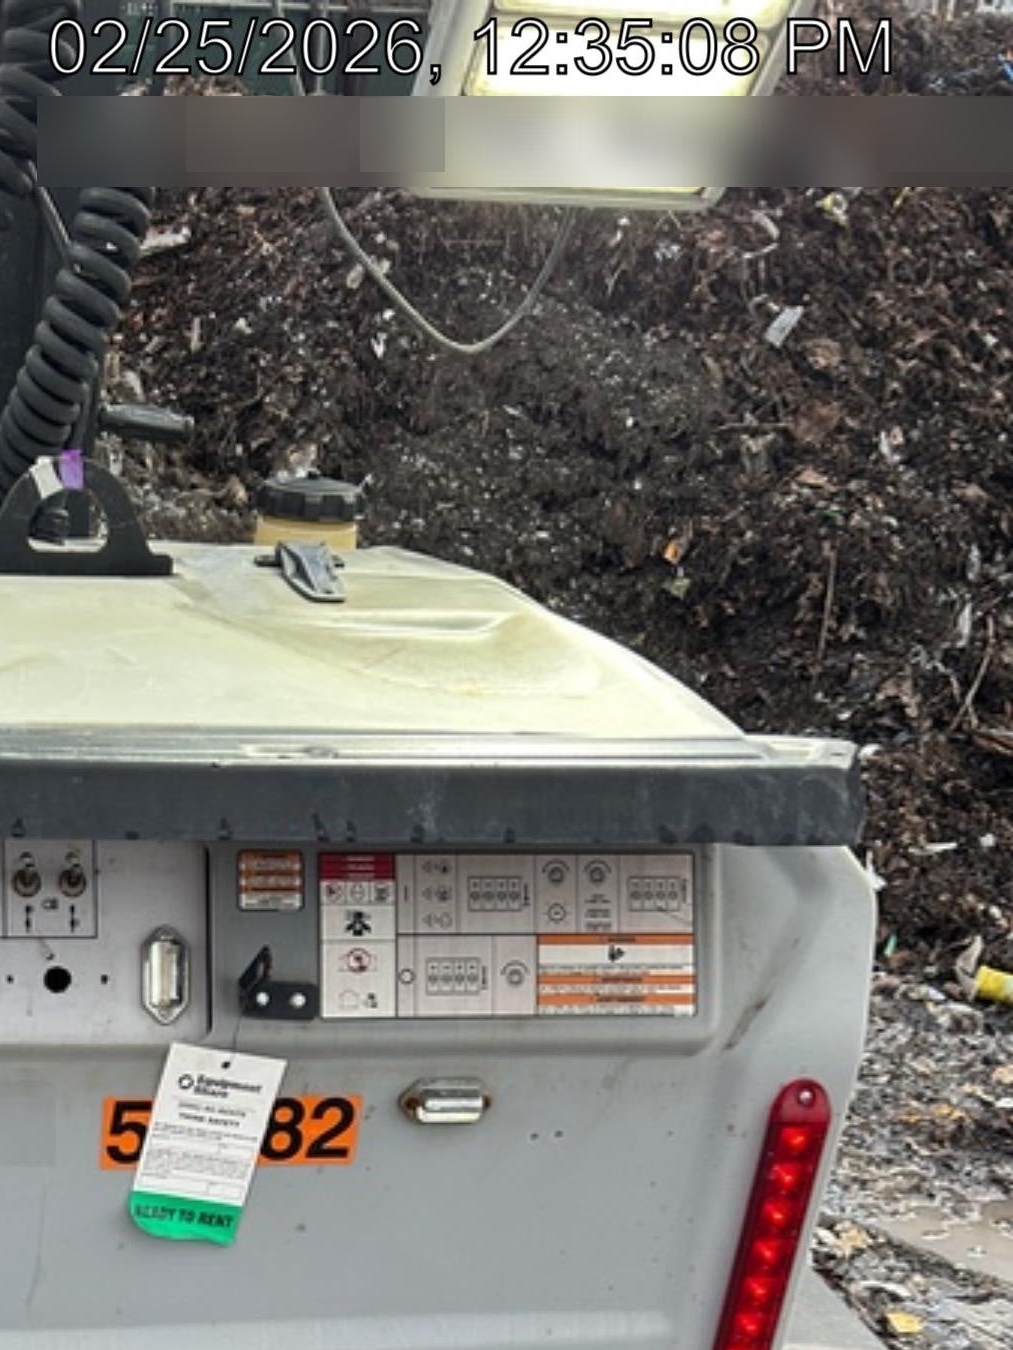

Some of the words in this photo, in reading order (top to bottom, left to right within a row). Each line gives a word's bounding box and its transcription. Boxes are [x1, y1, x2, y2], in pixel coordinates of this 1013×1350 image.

[106, 1097, 355, 1164] 582
[179, 1207, 196, 1225] TO
[198, 1210, 235, 1229] RENT
